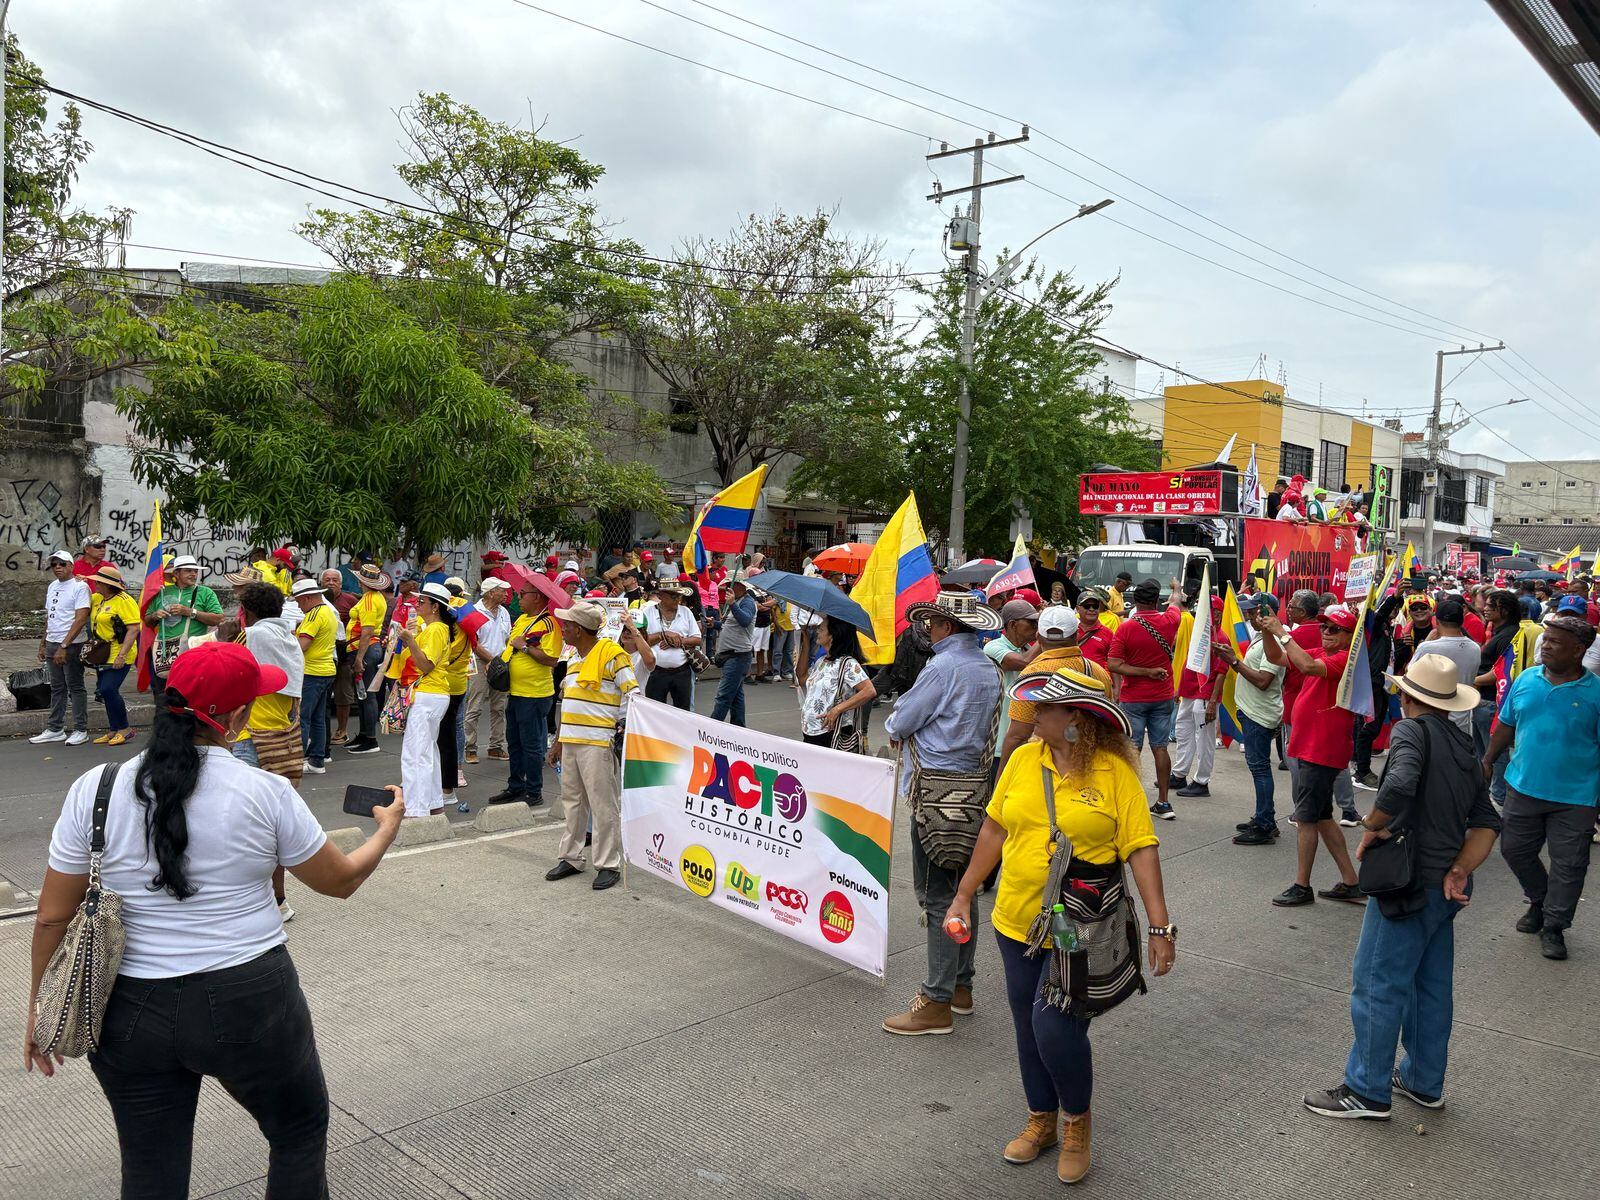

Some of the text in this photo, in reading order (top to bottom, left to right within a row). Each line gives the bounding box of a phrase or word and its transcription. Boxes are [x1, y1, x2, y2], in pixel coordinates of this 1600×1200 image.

[1082, 493, 1093, 501] DÍA
[1093, 493, 1144, 501] INTERNACIONAL
[1165, 492, 1186, 500] CLASE
[1092, 483, 1106, 492] DE
[1109, 482, 1140, 491] MAYO
[1289, 550, 1331, 576] CONSULTA
[698, 729, 798, 769] Moviemiento político
[687, 745, 808, 824] PACTO
[685, 796, 803, 844] HISTÓRICO
[690, 819, 790, 859] COLOMBIA PUEDE
[645, 848, 674, 868] COLOMBIA
[683, 858, 713, 882] POLO
[730, 867, 754, 895] UP
[829, 871, 879, 901] Polonuevo
[738, 898, 760, 911] PATRIÓTICA
[829, 912, 853, 932] MAIS
